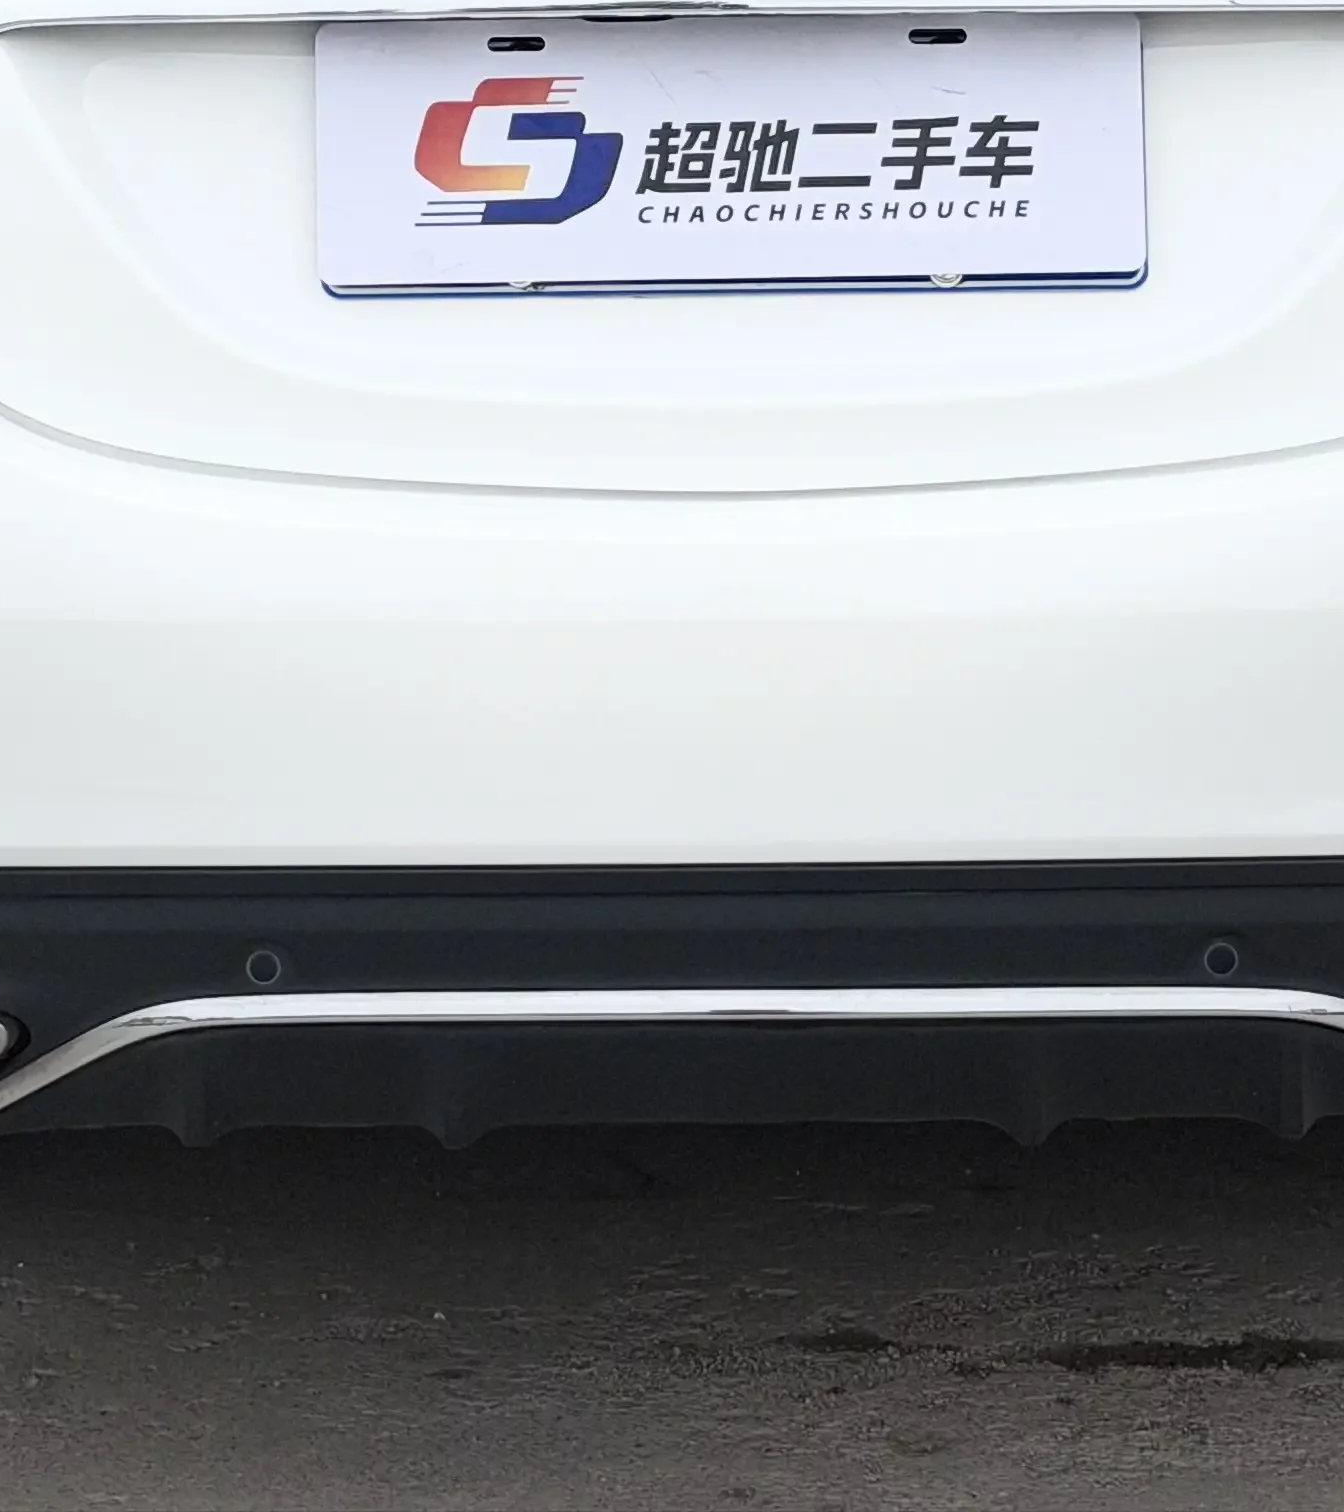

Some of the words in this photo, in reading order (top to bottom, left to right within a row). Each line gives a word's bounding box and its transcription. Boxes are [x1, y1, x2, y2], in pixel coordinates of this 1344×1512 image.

[635, 114, 1040, 195] 超驰二手车
[637, 199, 1031, 224] CHAOCHIERSHOUCHE
